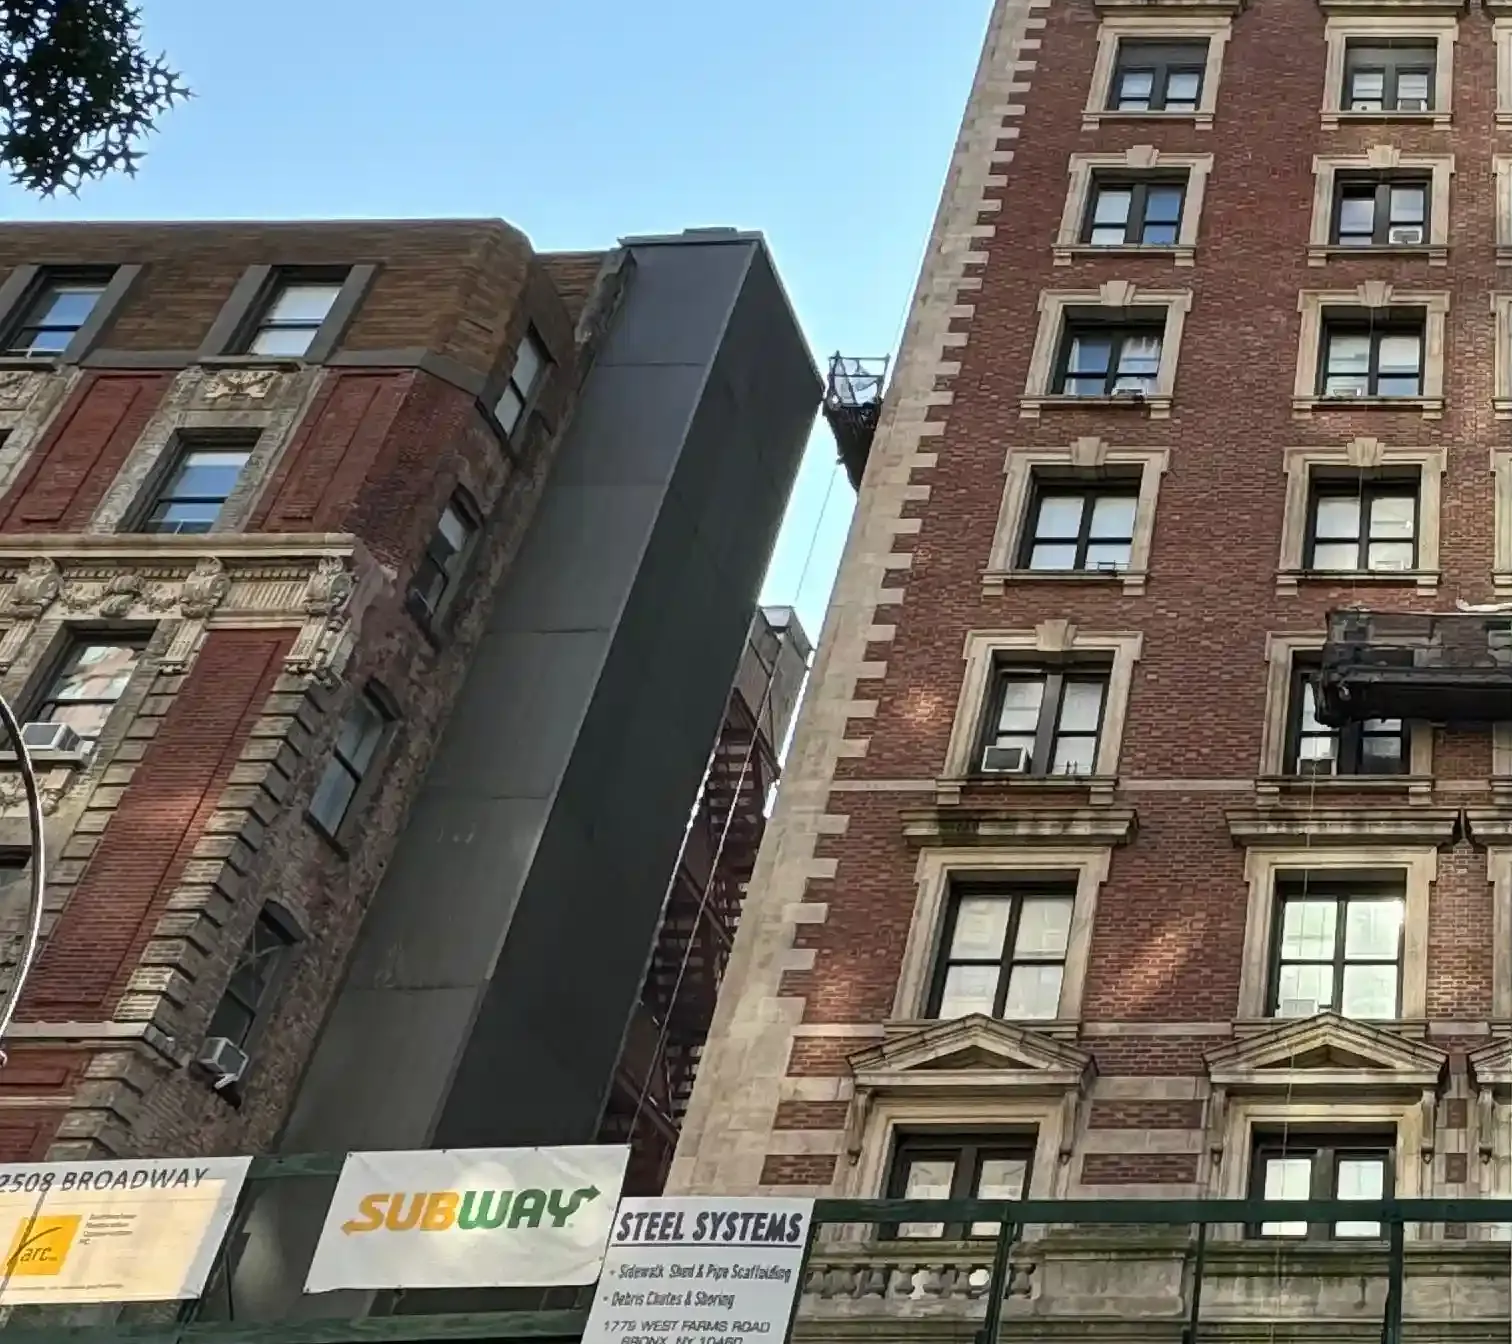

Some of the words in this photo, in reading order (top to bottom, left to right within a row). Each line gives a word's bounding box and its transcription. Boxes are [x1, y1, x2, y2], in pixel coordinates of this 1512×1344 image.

[0, 1172, 55, 1193] 2508
[60, 1167, 210, 1191] BROADWAY
[341, 1184, 601, 1236] SUBWAY
[616, 1211, 685, 1241] STEEL
[692, 1211, 803, 1242] SYSTEMS
[20, 1247, 52, 1263] arc
[706, 1264, 729, 1281] Pipe
[641, 1320, 679, 1332] WEST
[681, 1320, 728, 1333] FARMS
[731, 1320, 771, 1333] ROAD
